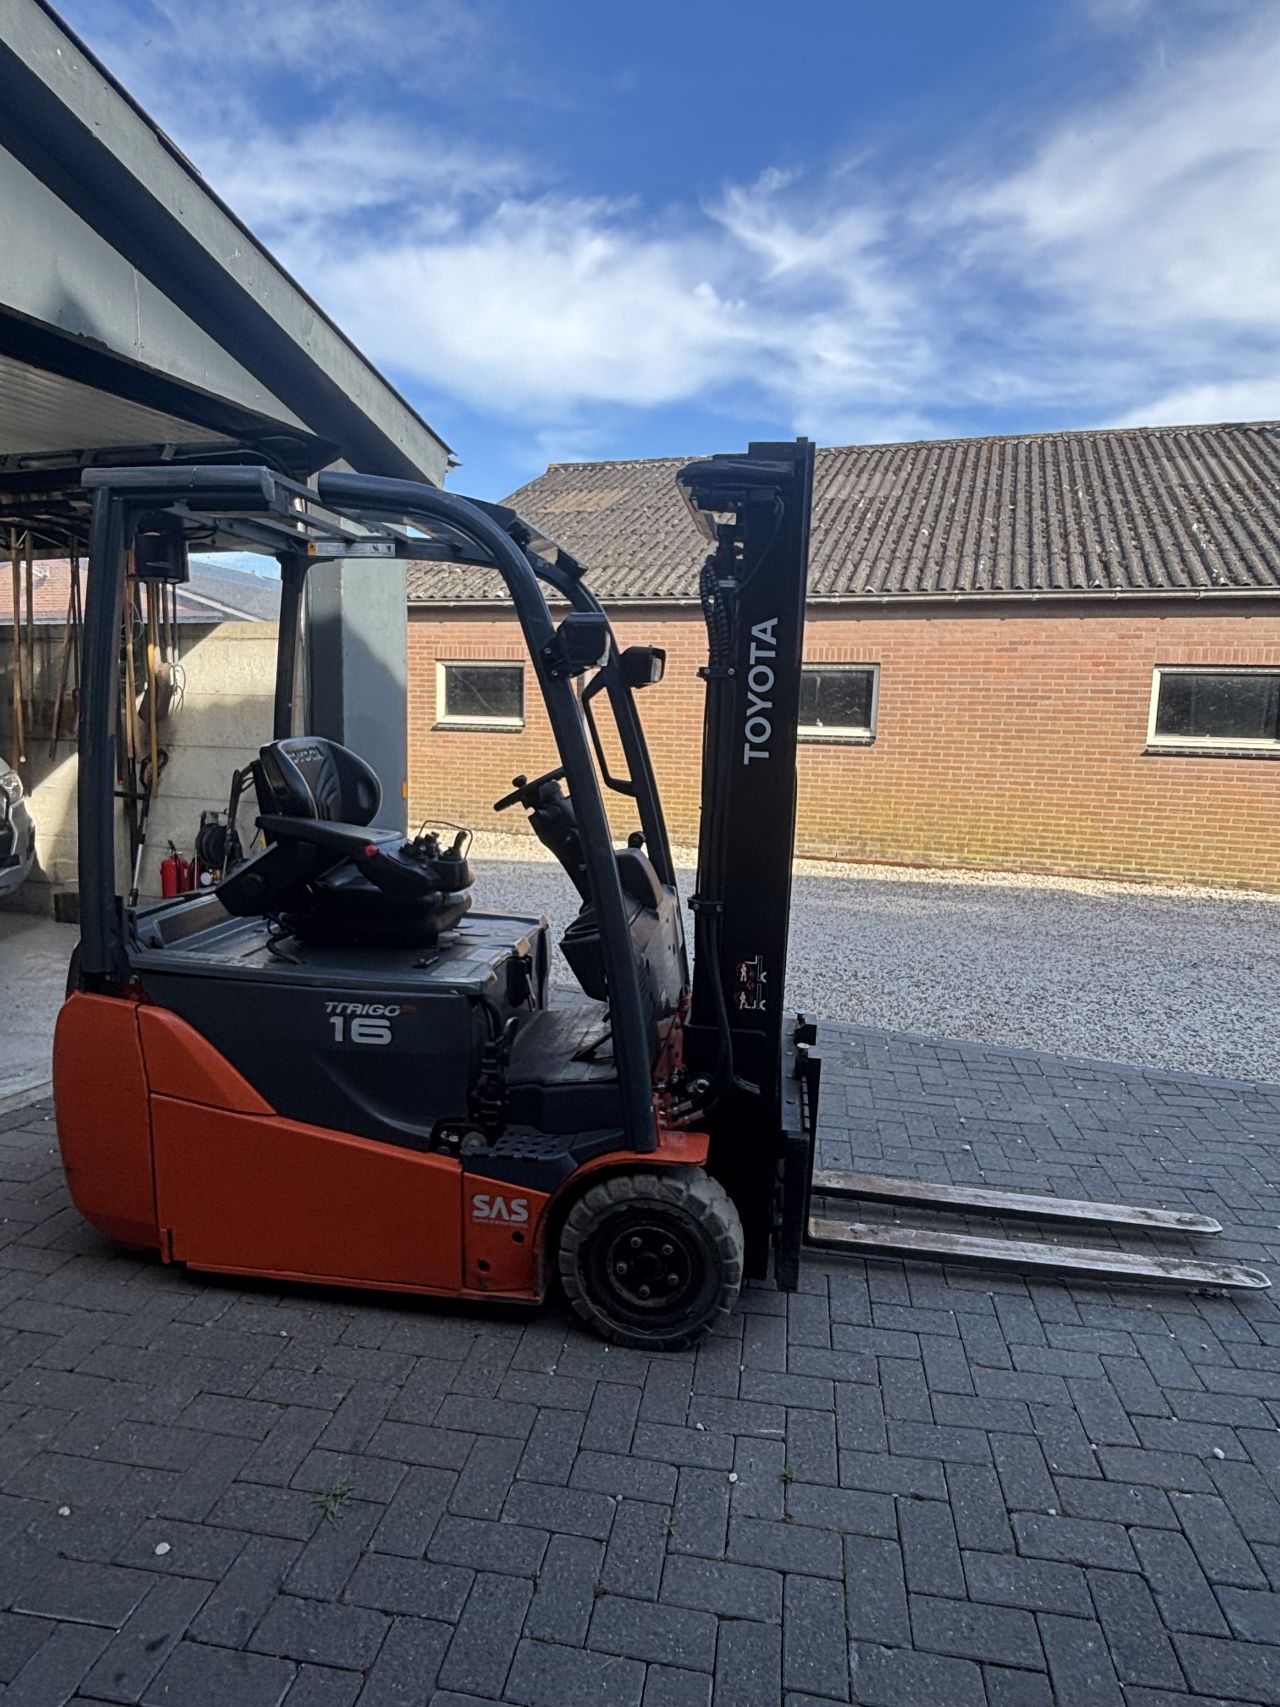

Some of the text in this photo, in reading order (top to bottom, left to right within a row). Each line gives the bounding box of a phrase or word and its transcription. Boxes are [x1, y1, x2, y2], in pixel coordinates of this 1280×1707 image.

[743, 617, 779, 765] TOYOTA
[329, 1015, 392, 1045] 16
[472, 1194, 529, 1222] SAS
